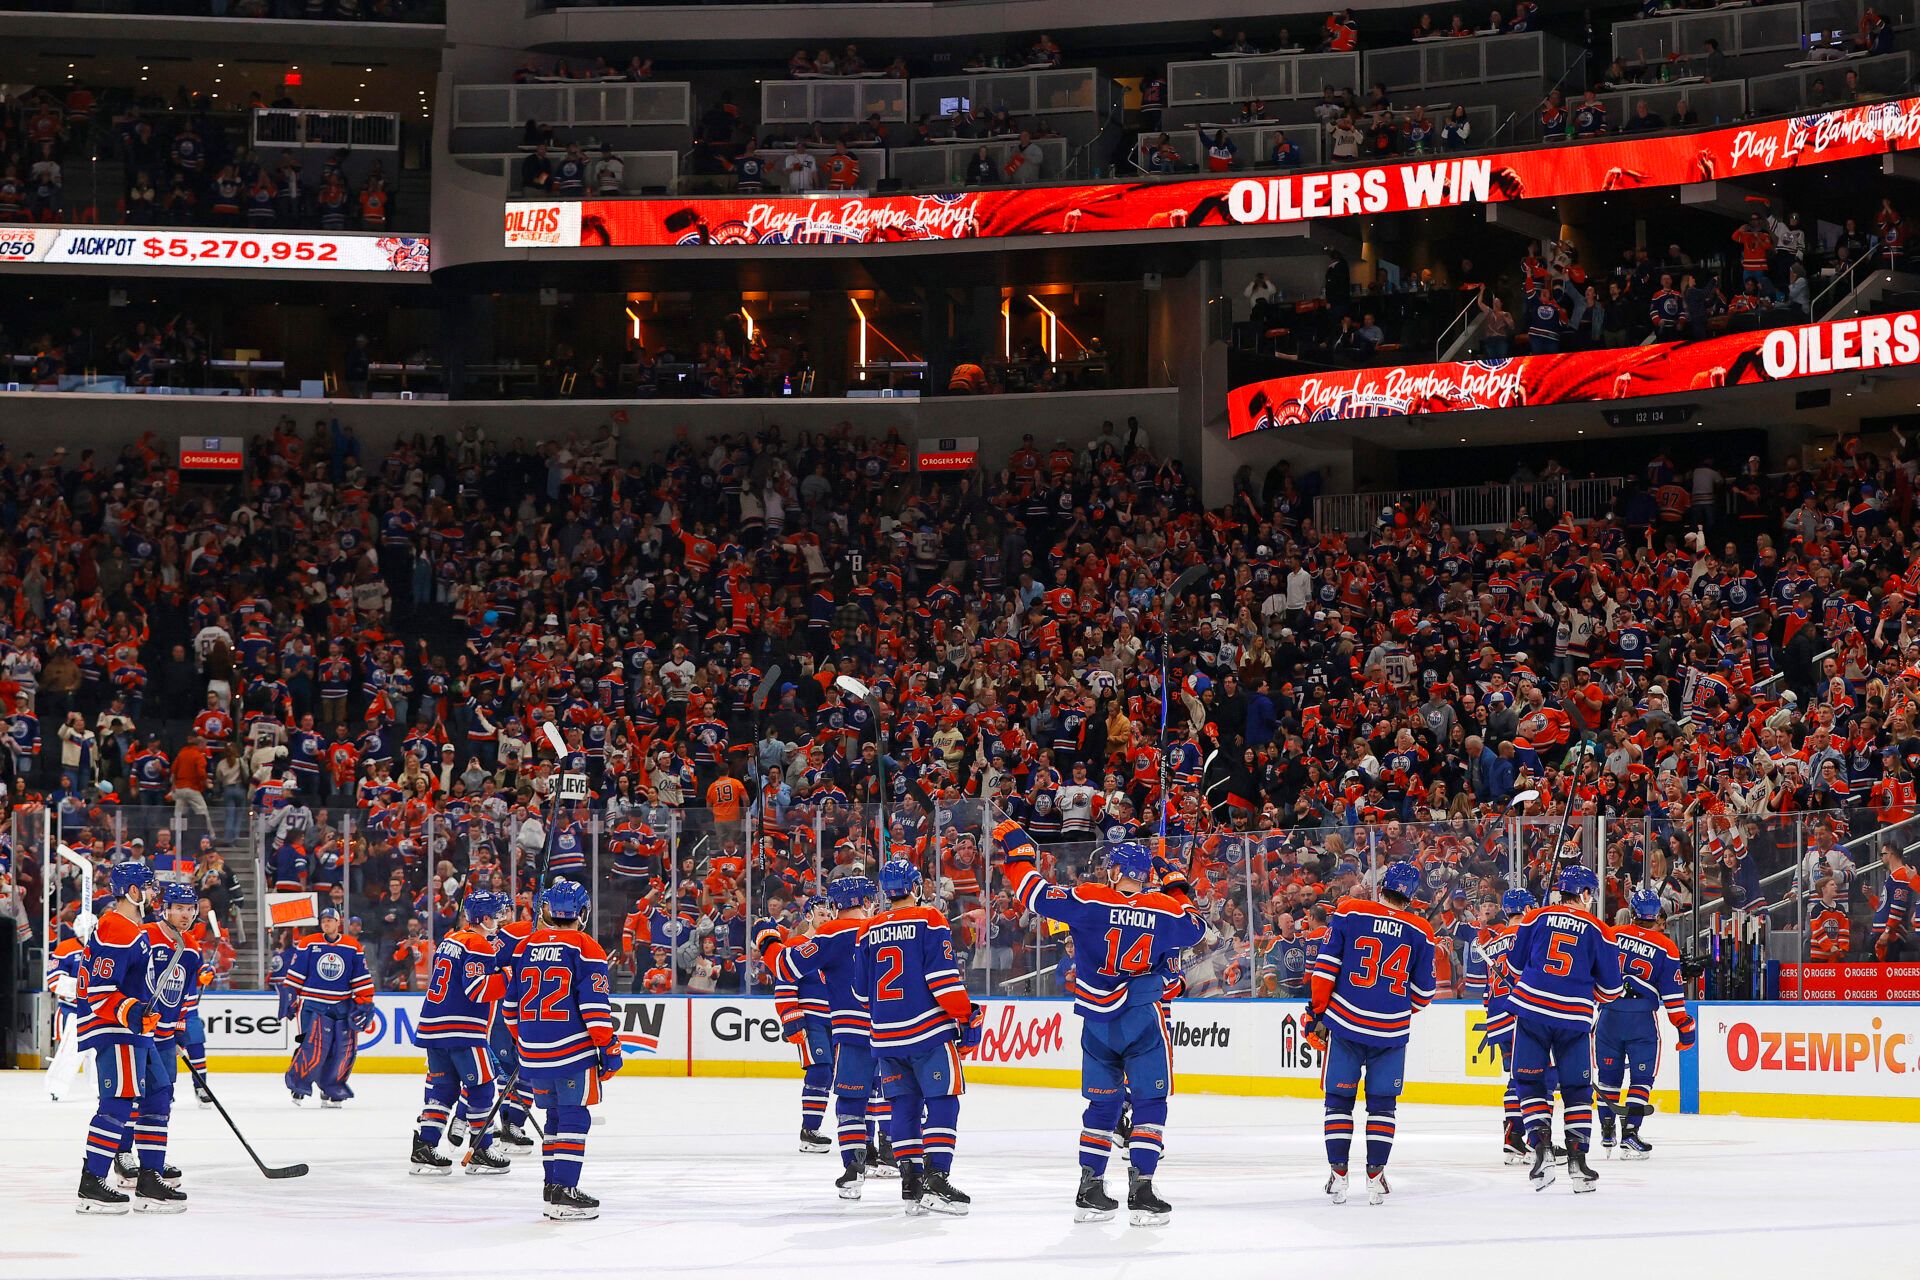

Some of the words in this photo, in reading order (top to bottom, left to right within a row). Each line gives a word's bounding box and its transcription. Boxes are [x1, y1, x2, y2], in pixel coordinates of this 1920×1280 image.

[1731, 131, 1778, 168] Play
[1781, 126, 1809, 158] La
[1883, 103, 1920, 142] bab
[1228, 169, 1388, 224] OILERS
[1400, 159, 1491, 208] WIN
[744, 204, 798, 243] Play
[801, 202, 834, 236] La
[916, 200, 977, 238] baby!
[813, 224, 861, 238] EDMONON
[0, 233, 34, 241] OFFS
[717, 223, 757, 243] COUNTY
[68, 237, 136, 256] JACKPOT
[143, 237, 338, 263] $5,270,952
[1762, 314, 1920, 379] OILERS
[1298, 378, 1344, 418] Play
[1349, 373, 1379, 408] La
[1460, 365, 1524, 407] baby!
[1357, 394, 1406, 408] EDMONON
[1277, 403, 1307, 422] COUNTY
[1635, 413, 1647, 422] 132
[1652, 412, 1664, 421] 134
[192, 456, 218, 464] ROGERS
[715, 785, 733, 803] 19
[286, 815, 305, 830] 97
[84, 875, 92, 912] BAUER
[1110, 909, 1156, 929] EKHOLM
[1373, 919, 1403, 937] DACH
[1546, 915, 1588, 934] MURPHY
[869, 924, 916, 944] OUCHARD
[529, 947, 562, 962] SAVOIE
[1097, 927, 1155, 977] 14
[1543, 932, 1579, 977] 5
[1616, 936, 1657, 958] KAPANEN
[92, 957, 115, 980] 96
[465, 961, 486, 978] 93
[876, 946, 905, 1001] 2
[1349, 935, 1412, 997] 34
[1811, 968, 1836, 977] ROGERS
[1852, 968, 1878, 977] ROGERS
[1894, 968, 1920, 977] ROGERS
[427, 957, 453, 1004] 3
[519, 966, 573, 1022] 22
[1811, 989, 1836, 999] ROGERS
[1852, 989, 1878, 999] ROGERS
[1894, 989, 1920, 999] ROGERS
[203, 1009, 281, 1034] rise
[1718, 1022, 1727, 1033] Pr
[836, 1083, 864, 1091] BAUER
